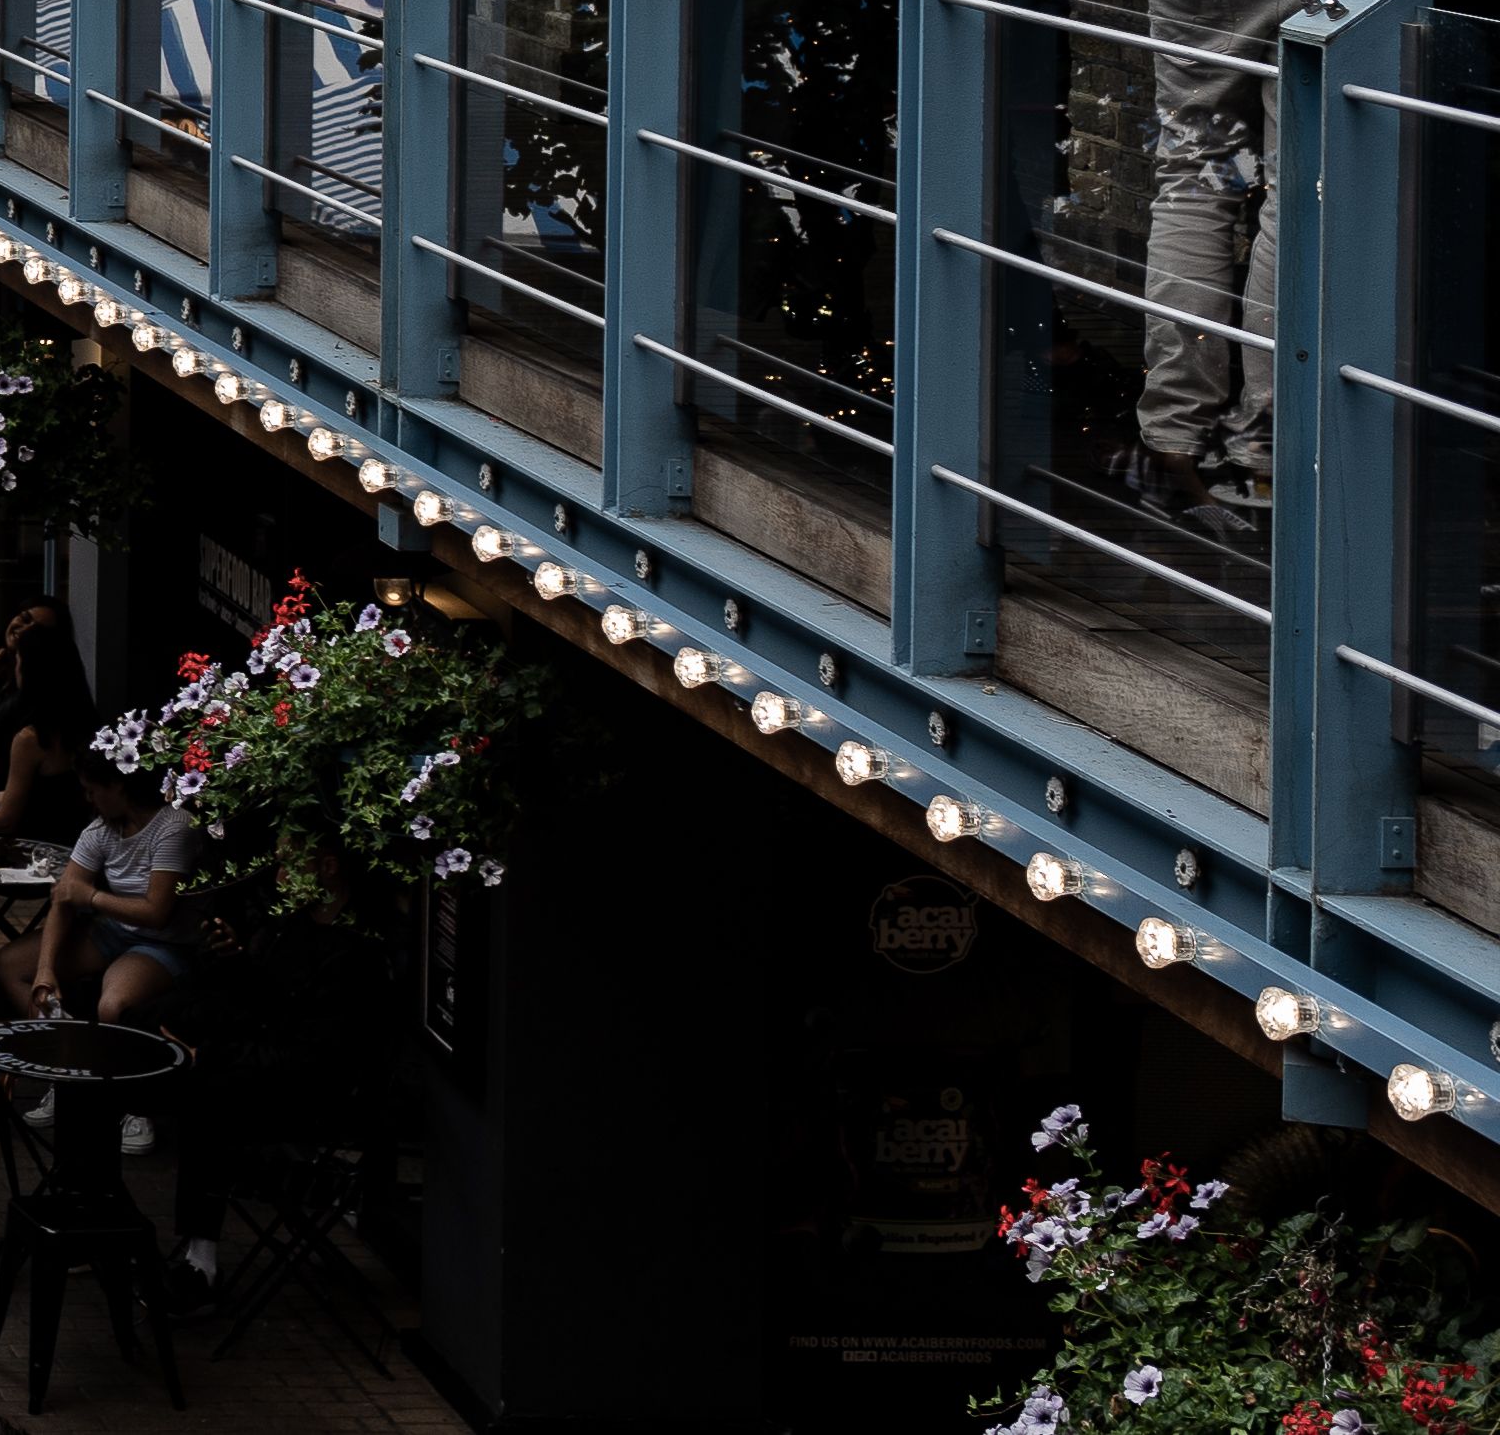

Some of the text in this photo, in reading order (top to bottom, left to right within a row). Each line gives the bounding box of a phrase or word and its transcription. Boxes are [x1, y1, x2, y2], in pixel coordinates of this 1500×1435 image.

[879, 918, 975, 958] berry
[876, 1126, 972, 1172] berry
[789, 1335, 1047, 1351] FIND US ON WWW.ACAIBERRYFOODS.COM
[879, 1350, 993, 1364] ACAIBERRYFOODS
